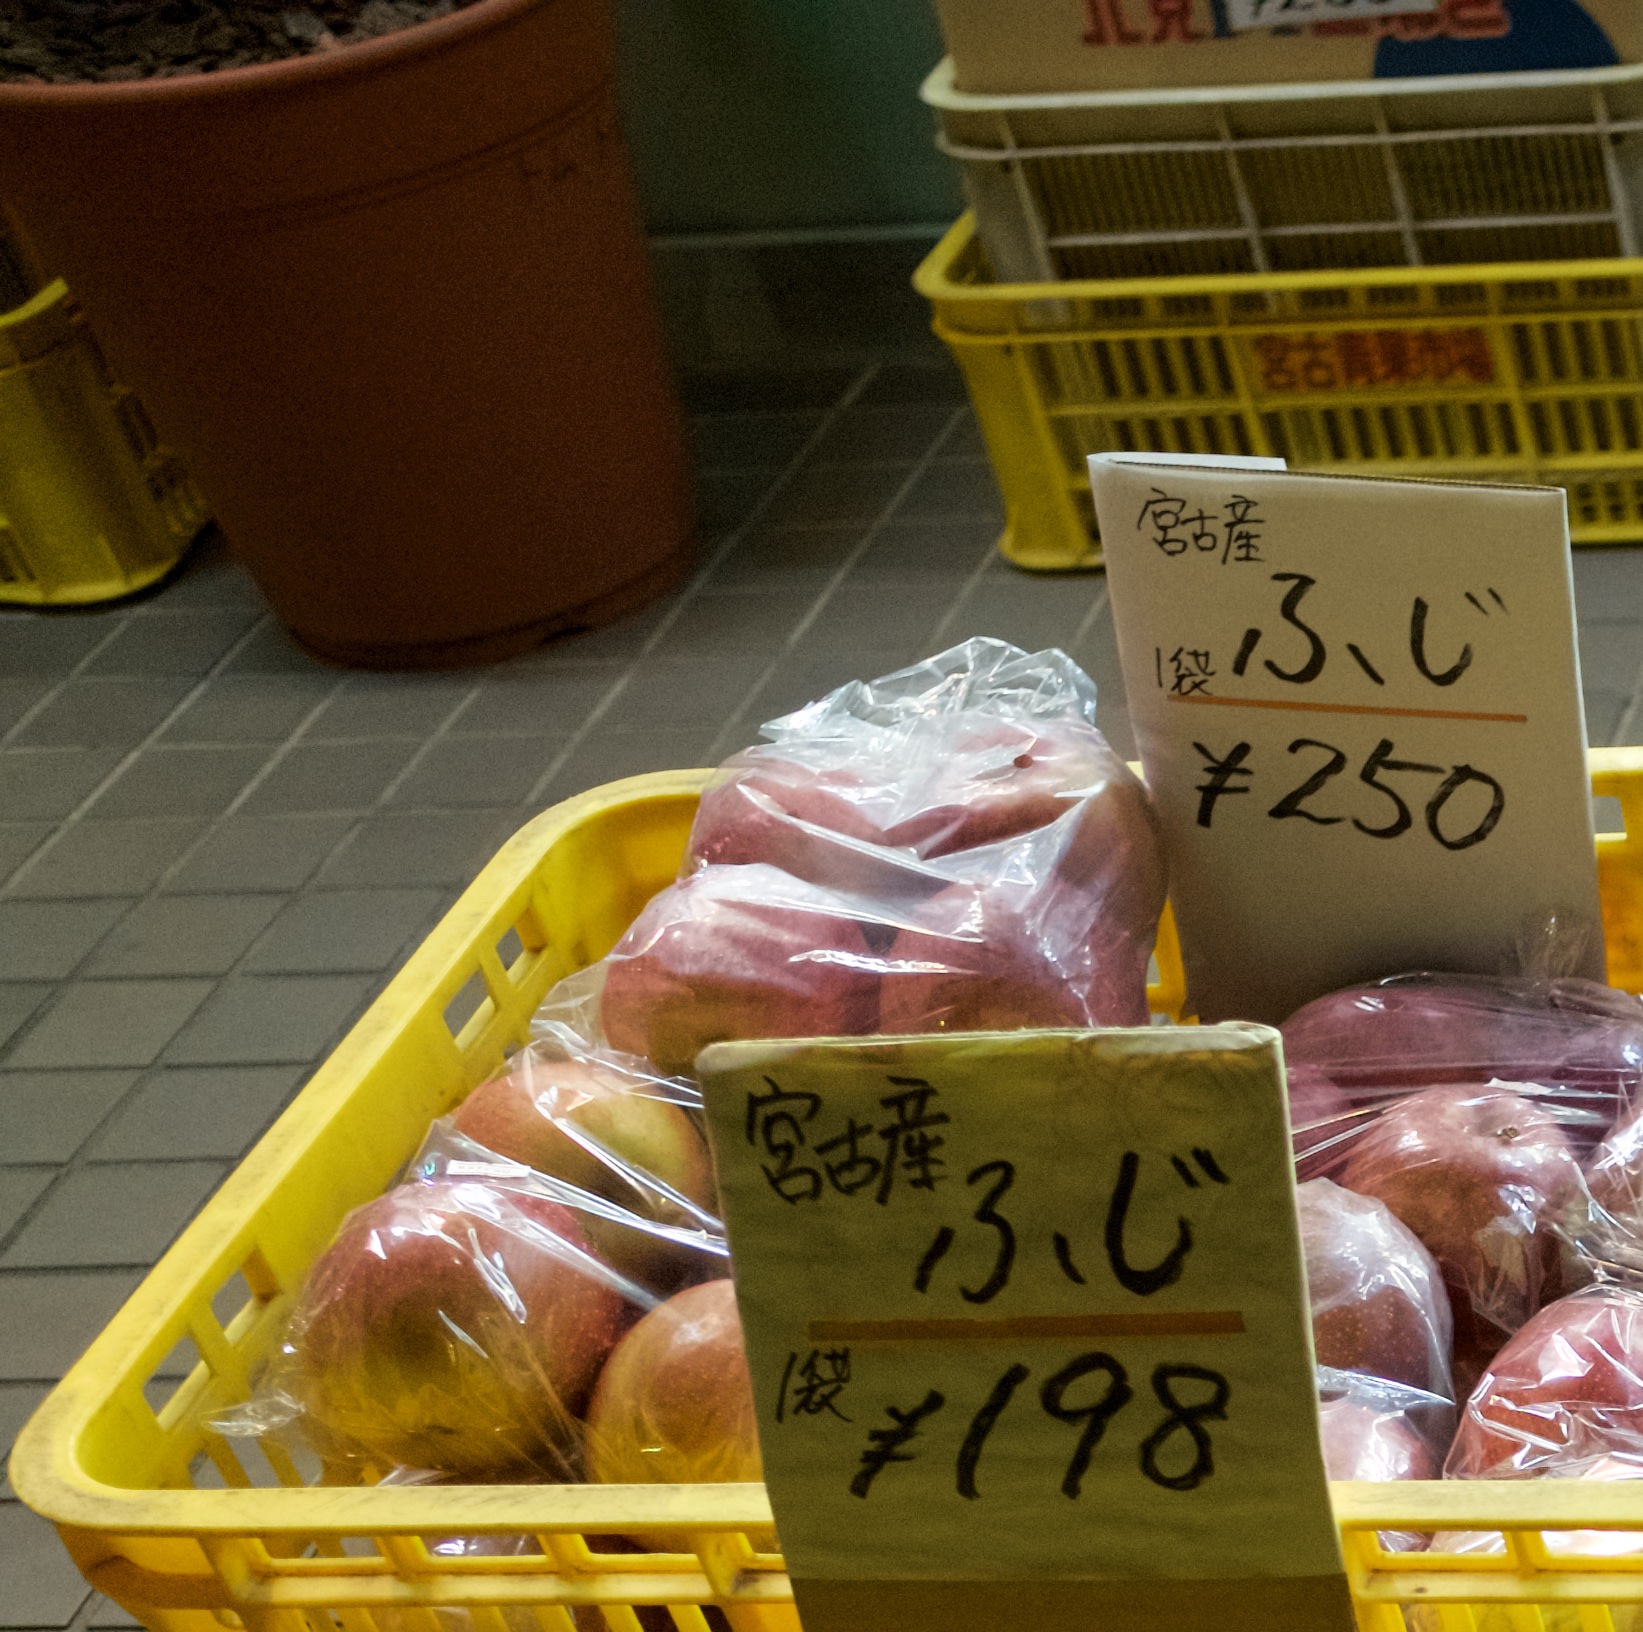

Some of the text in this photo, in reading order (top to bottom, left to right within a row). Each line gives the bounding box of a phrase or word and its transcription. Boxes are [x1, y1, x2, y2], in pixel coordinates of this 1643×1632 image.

[1137, 488, 1266, 565] 宮古産
[1233, 573, 1508, 687] ふじ
[1193, 738, 1505, 850] ¥250
[745, 1075, 951, 1205] 宮古産
[914, 1148, 1230, 1303] ふじ
[849, 1351, 1230, 1500] ¥198
